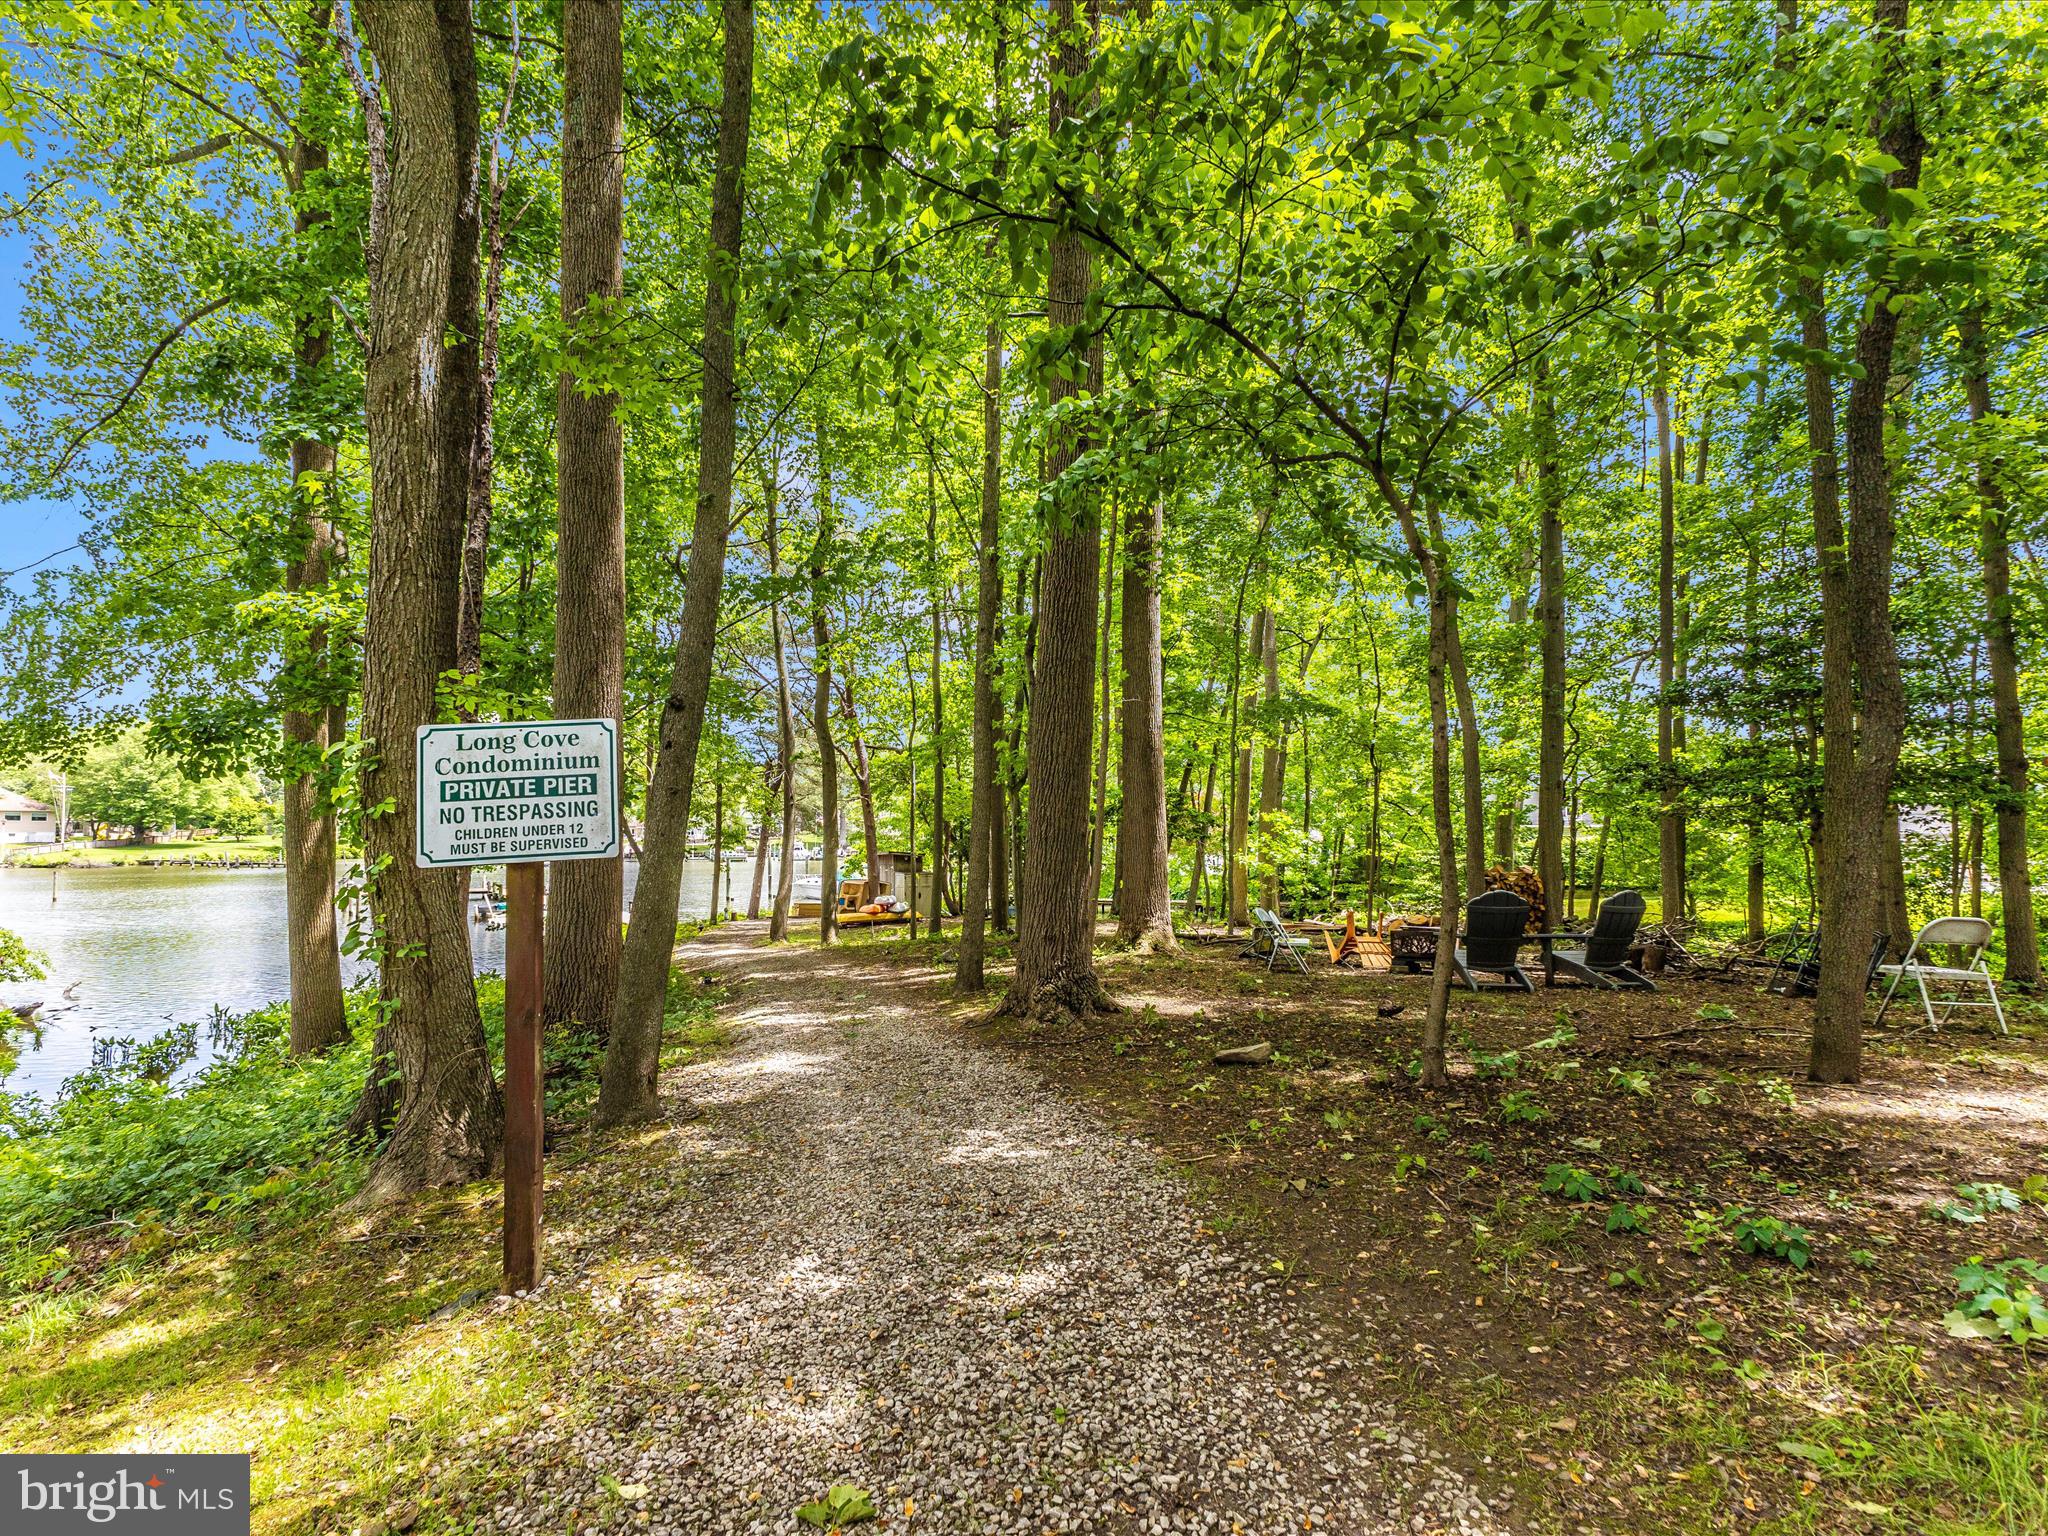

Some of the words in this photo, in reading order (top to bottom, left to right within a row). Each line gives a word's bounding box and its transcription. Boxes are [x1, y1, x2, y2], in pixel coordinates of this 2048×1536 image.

[456, 733, 516, 754] Long
[523, 730, 580, 748] Cove
[435, 752, 600, 776] Condominium
[445, 779, 536, 800] PRIVATE
[543, 776, 592, 795] PIER
[440, 807, 465, 824] NO
[472, 800, 598, 822] TRESPASSING
[455, 827, 518, 841] CHILDREN
[522, 824, 564, 837] UNDER
[569, 823, 584, 834] 12
[450, 843, 487, 855] MUST
[491, 840, 508, 853] BE
[510, 837, 588, 852] SUPERVISED
